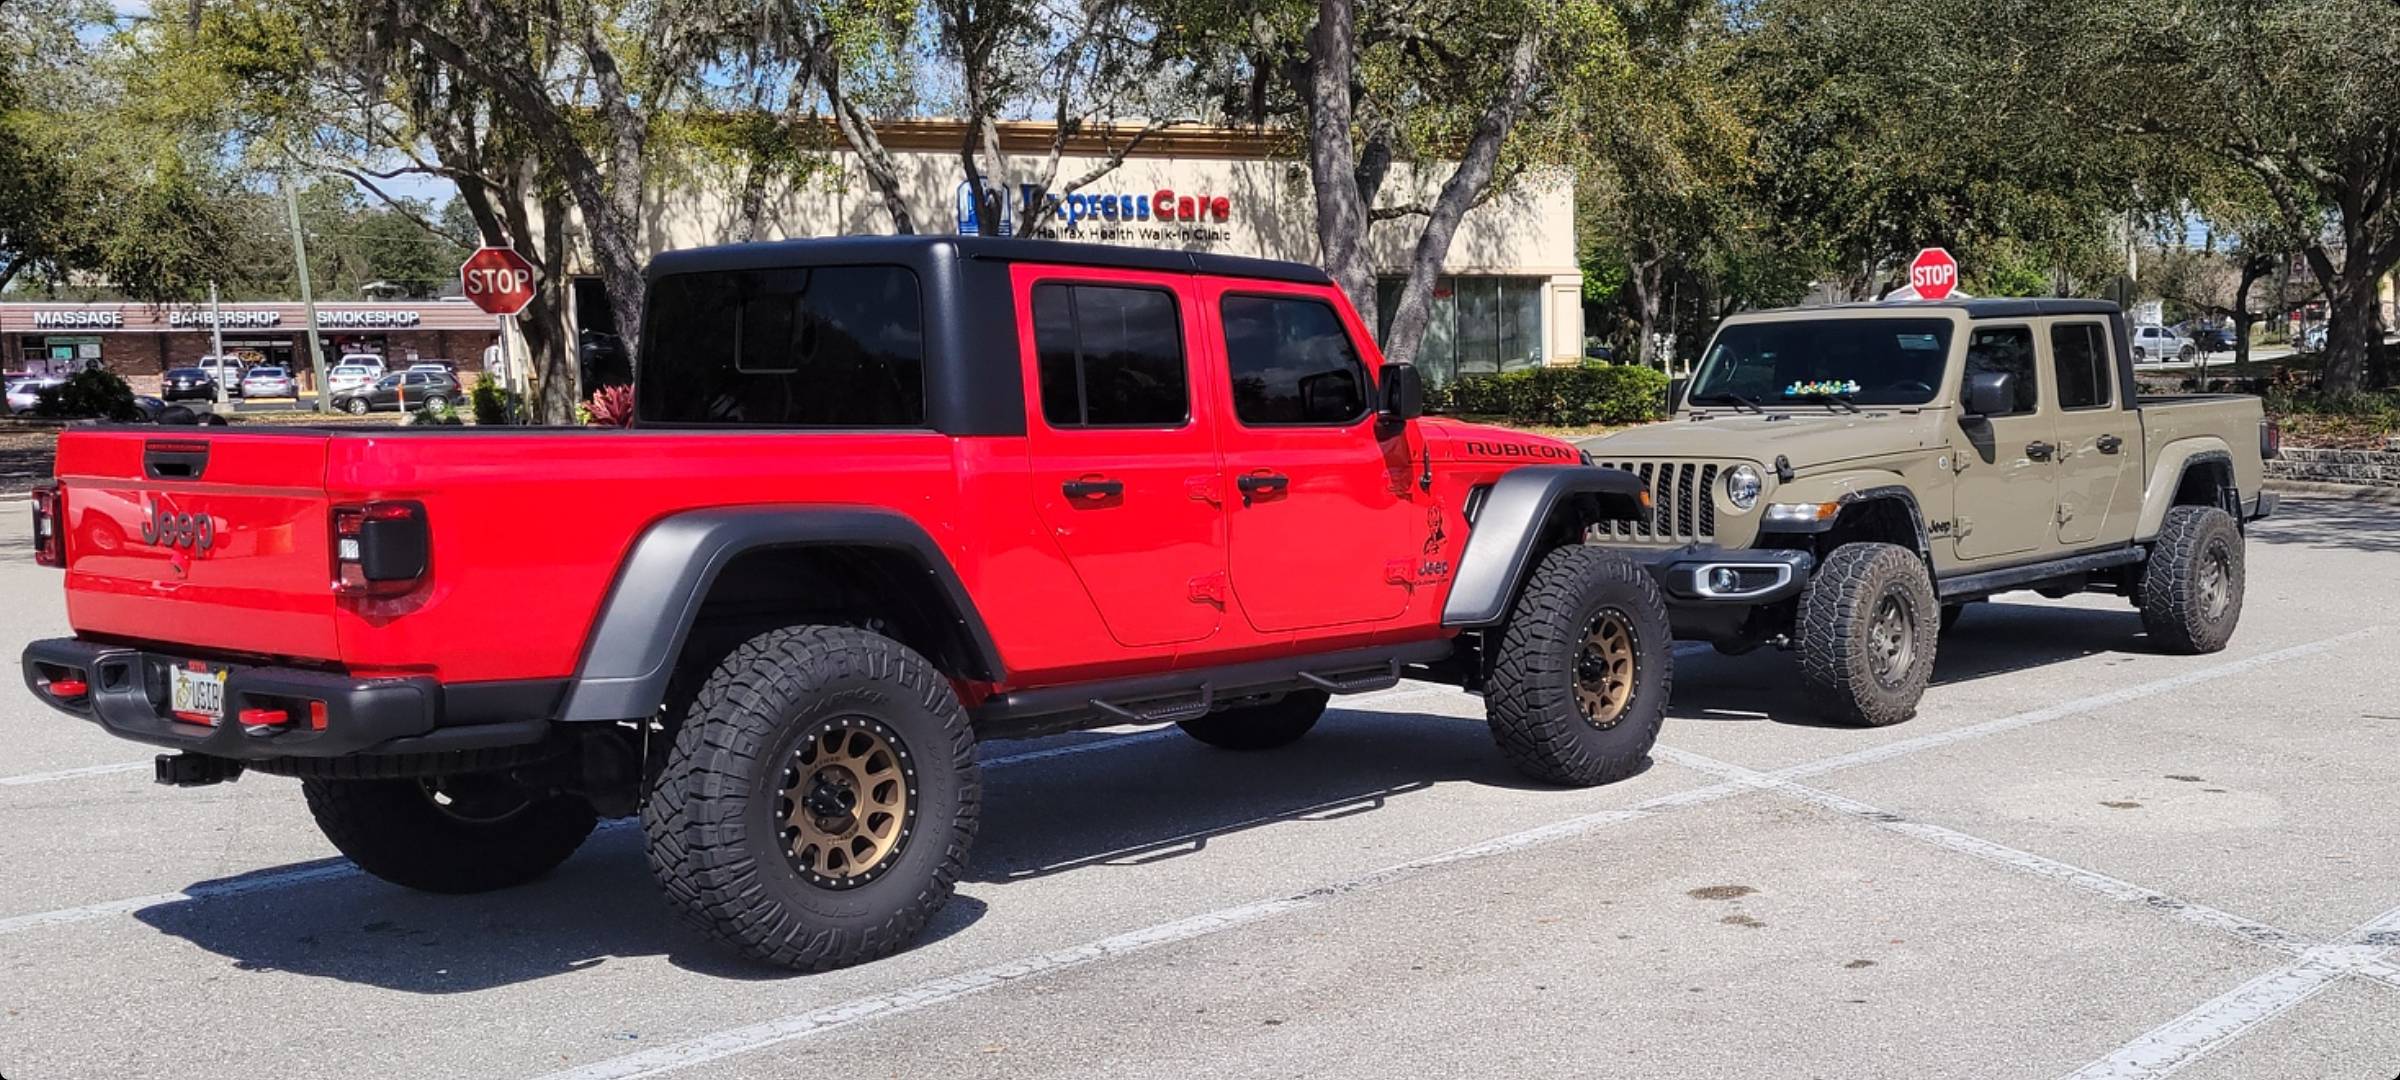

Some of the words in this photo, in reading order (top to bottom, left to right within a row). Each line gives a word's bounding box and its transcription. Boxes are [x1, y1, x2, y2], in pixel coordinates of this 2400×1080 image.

[1038, 226, 1085, 240] Halifax
[1090, 227, 1133, 240] Health
[1193, 227, 1231, 241] Clinic
[468, 268, 529, 295] STOP
[1914, 264, 1954, 288] STOP
[33, 311, 123, 325] MASSAGE
[169, 311, 280, 325] BARBERSHOP
[316, 311, 420, 325] SMOKESHOP
[1467, 442, 1572, 459] RUBICON
[141, 498, 213, 559] Jeep
[1928, 519, 1951, 534] Jeep
[1418, 559, 1448, 576] Jeep
